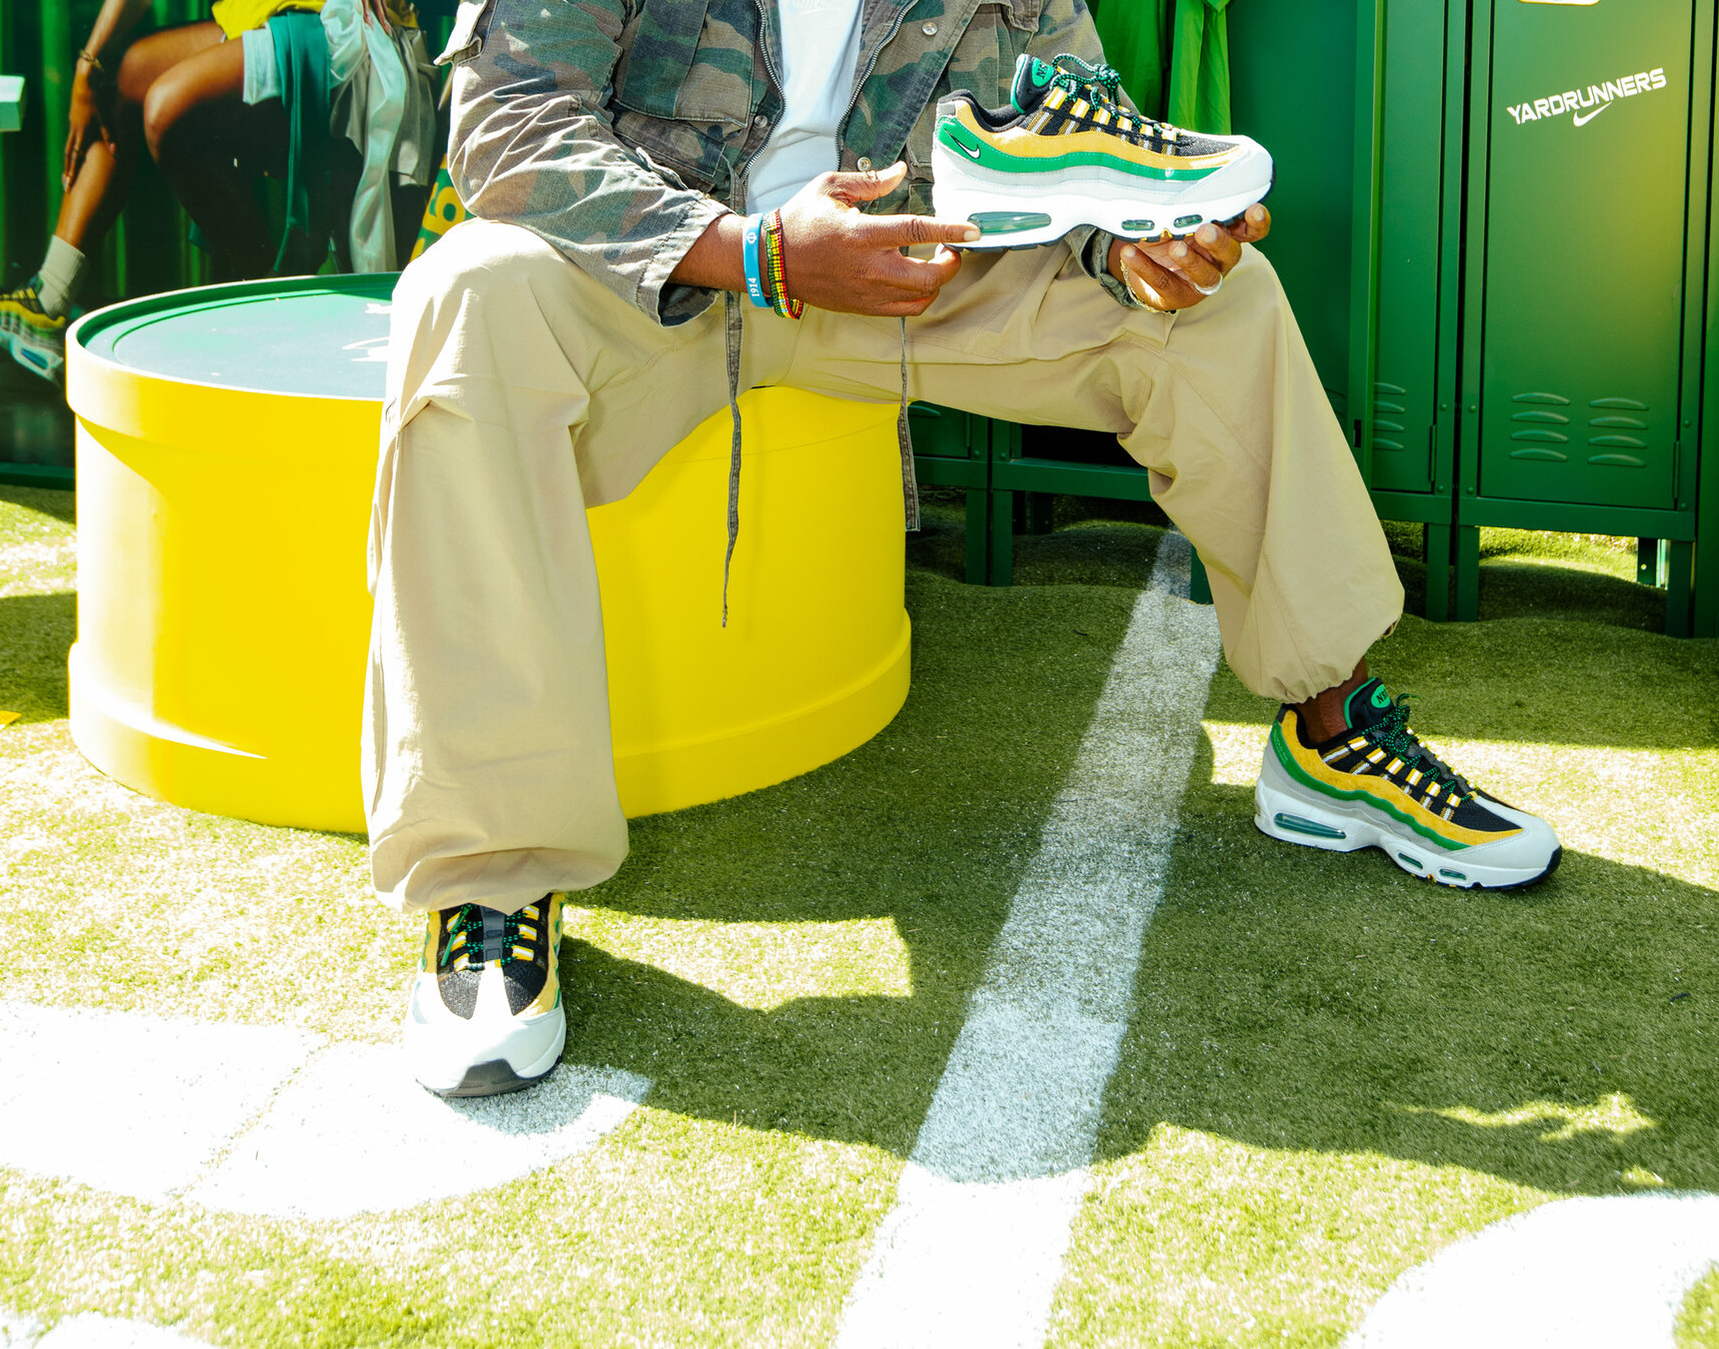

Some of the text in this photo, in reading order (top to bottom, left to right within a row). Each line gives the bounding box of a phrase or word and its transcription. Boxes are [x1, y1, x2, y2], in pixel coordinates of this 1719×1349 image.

[1036, 61, 1048, 80] NS
[1506, 67, 1667, 125] YARDRUNNERS
[748, 277, 760, 297] 1914
[1376, 689, 1388, 705] NS
